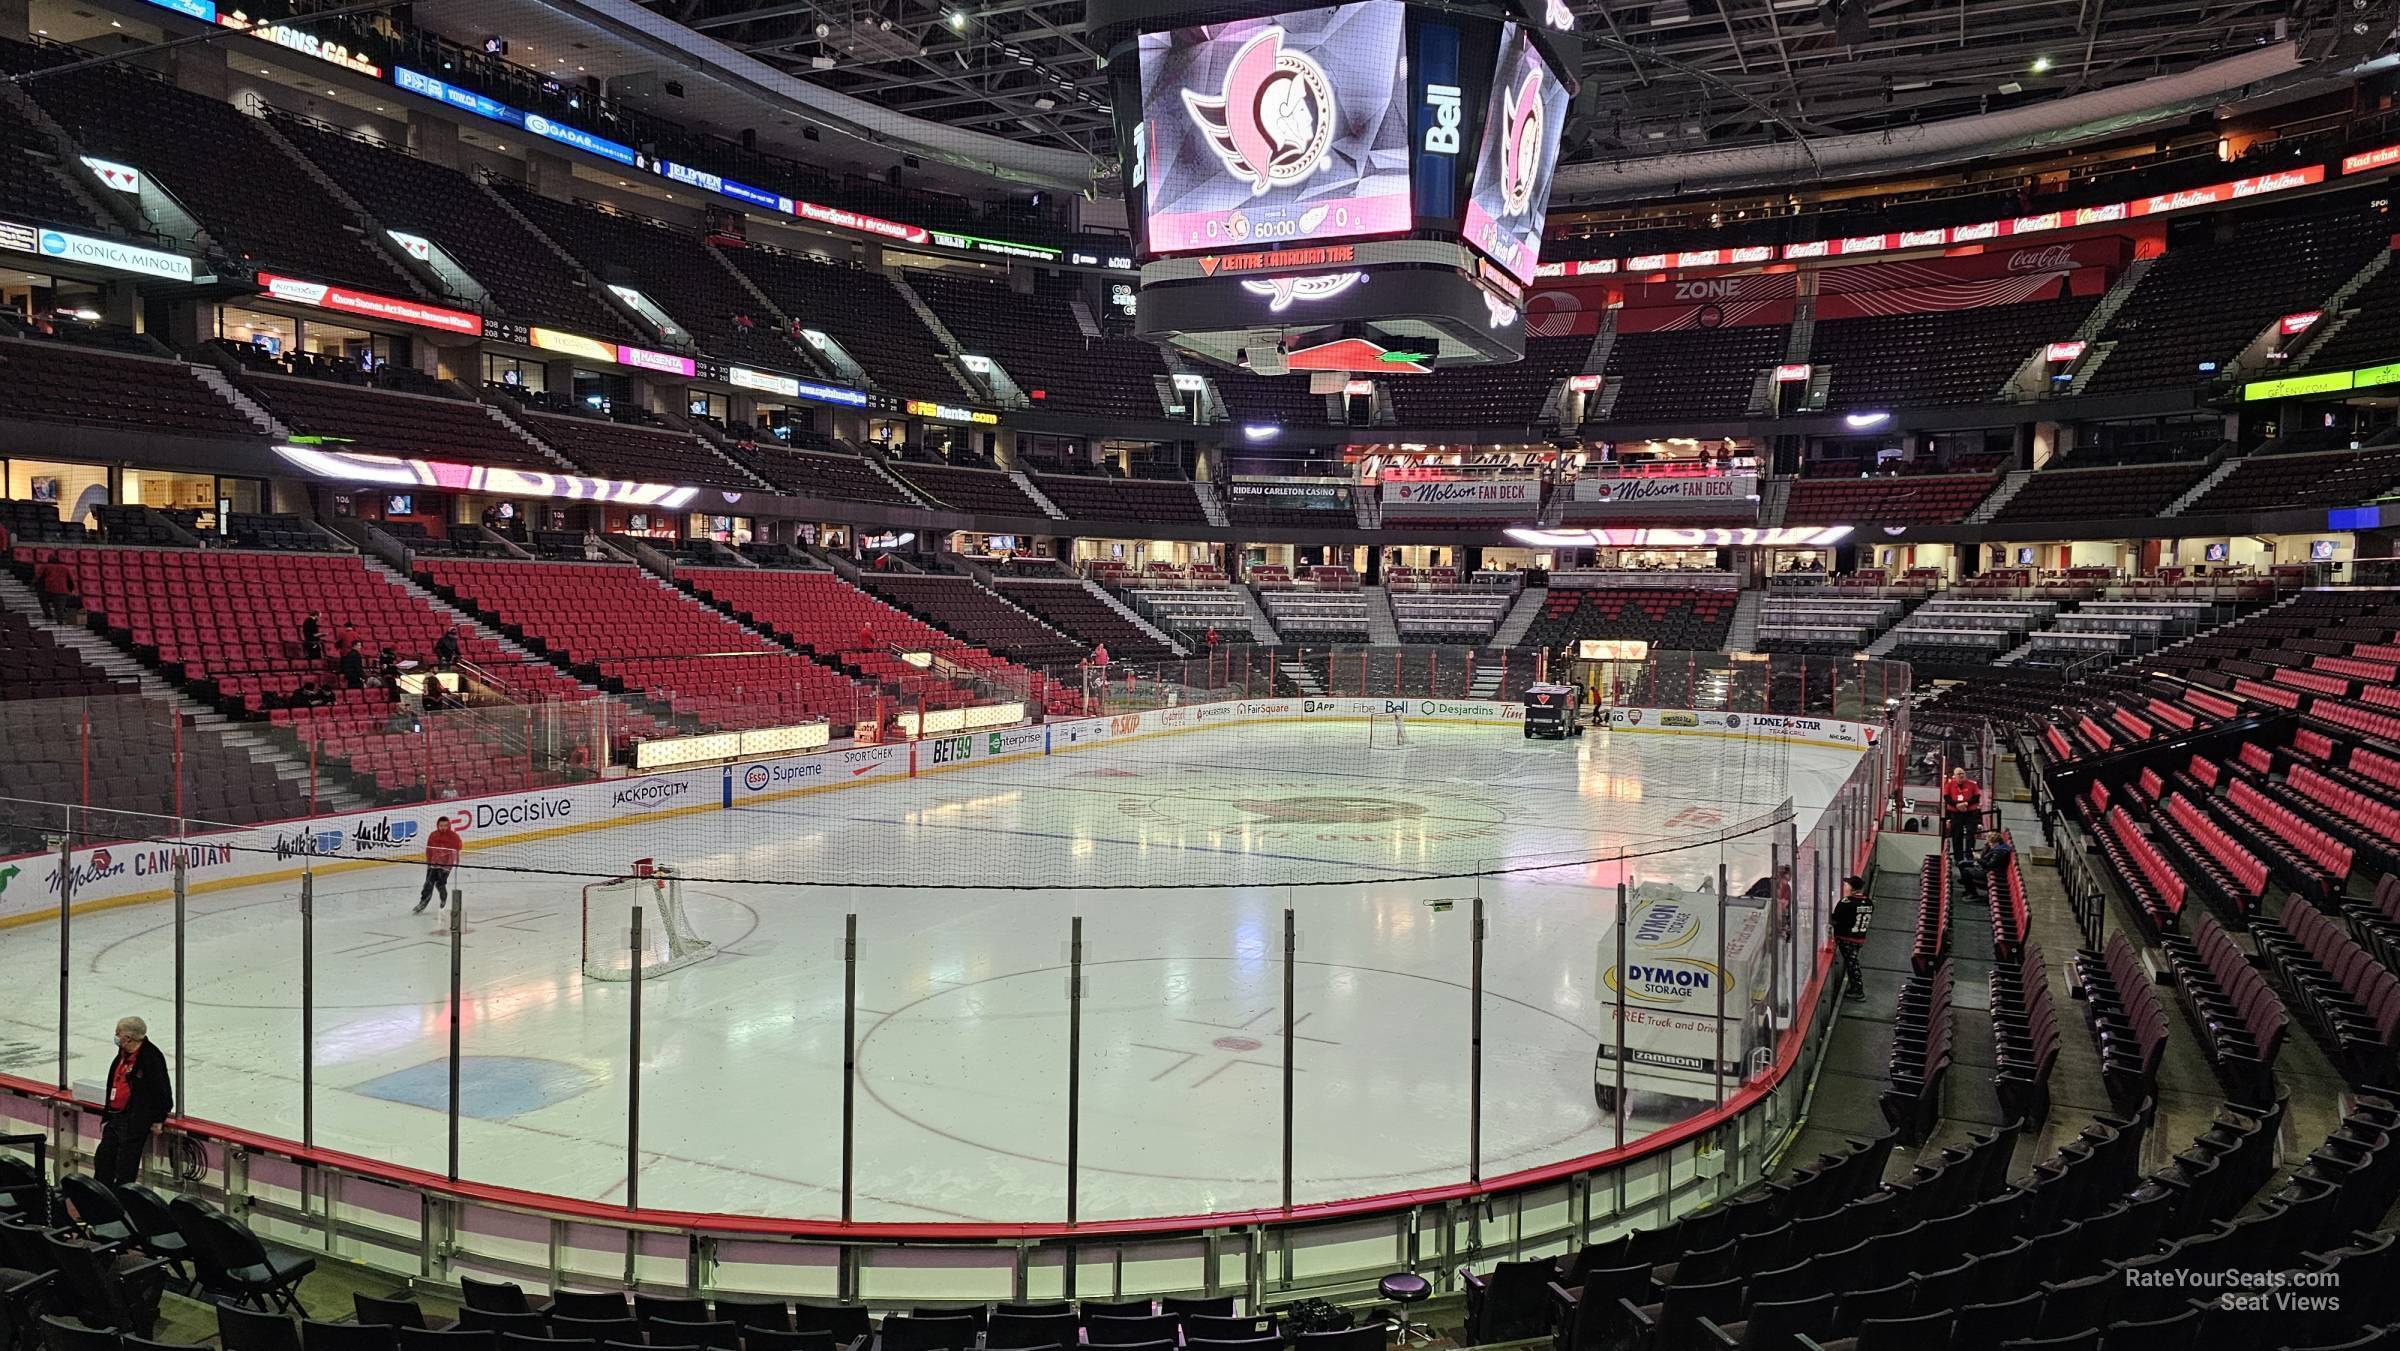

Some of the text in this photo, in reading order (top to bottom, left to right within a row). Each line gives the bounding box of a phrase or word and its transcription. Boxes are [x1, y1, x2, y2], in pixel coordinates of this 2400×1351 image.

[1425, 84, 1461, 154] Bell
[550, 127, 592, 147] GADAR
[2346, 148, 2398, 170] Find what
[2233, 173, 2304, 197] Tim Hortons
[2149, 191, 2216, 213] Tim Hortons
[802, 203, 855, 226] PowerSports
[876, 221, 907, 236] CANADA
[1336, 209, 1348, 227] 0
[2081, 205, 2122, 223] Coca-Cola
[1206, 221, 1217, 238] 0
[1255, 221, 1295, 238] 60:00
[72, 242, 190, 275] KONICA MINOLTA
[1222, 246, 1354, 271] CENTRE CANADIAN TIRE
[2008, 243, 2076, 271] Coca-Cola
[1112, 284, 1132, 295] GO
[1676, 279, 1742, 299] ZONE
[484, 319, 499, 329] 308
[514, 325, 527, 334] 309
[484, 329, 499, 339] 208
[514, 335, 527, 344] 209
[641, 351, 682, 369] MAGENTA
[696, 361, 708, 370] 309
[696, 370, 708, 378] 209
[1233, 486, 1336, 497] RIDEAU CARLETON CASINO
[1414, 483, 1525, 501] Molson FAN DECK
[1613, 480, 1733, 500] Molson FAN DECK
[336, 496, 350, 504] 106
[553, 511, 565, 519] 106
[1247, 704, 1289, 714] FairSquare
[1316, 702, 1335, 712] APP
[1353, 703, 1376, 713] Fibe
[1385, 700, 1409, 715] Bell
[1439, 703, 1494, 716] Desjardins
[1501, 704, 1523, 719] Tim
[1121, 715, 1140, 734] SKIP
[1753, 717, 1821, 731] LONE STAR
[990, 731, 1041, 749] enterprise
[933, 736, 973, 764] BET99
[748, 763, 822, 783] Esso Supreme
[612, 781, 689, 808] JACKPOTCITY
[476, 797, 572, 829] Decisive
[1634, 904, 1679, 942] DYMON
[1667, 913, 1692, 934] STORAGE
[1851, 913, 1872, 933] 18
[1629, 965, 1709, 989] DYMON
[1645, 983, 1693, 998] STORAGE
[1648, 1016, 1672, 1029] Truck
[1675, 1020, 1694, 1032] and
[1635, 1052, 1700, 1068] ZAMBONI
